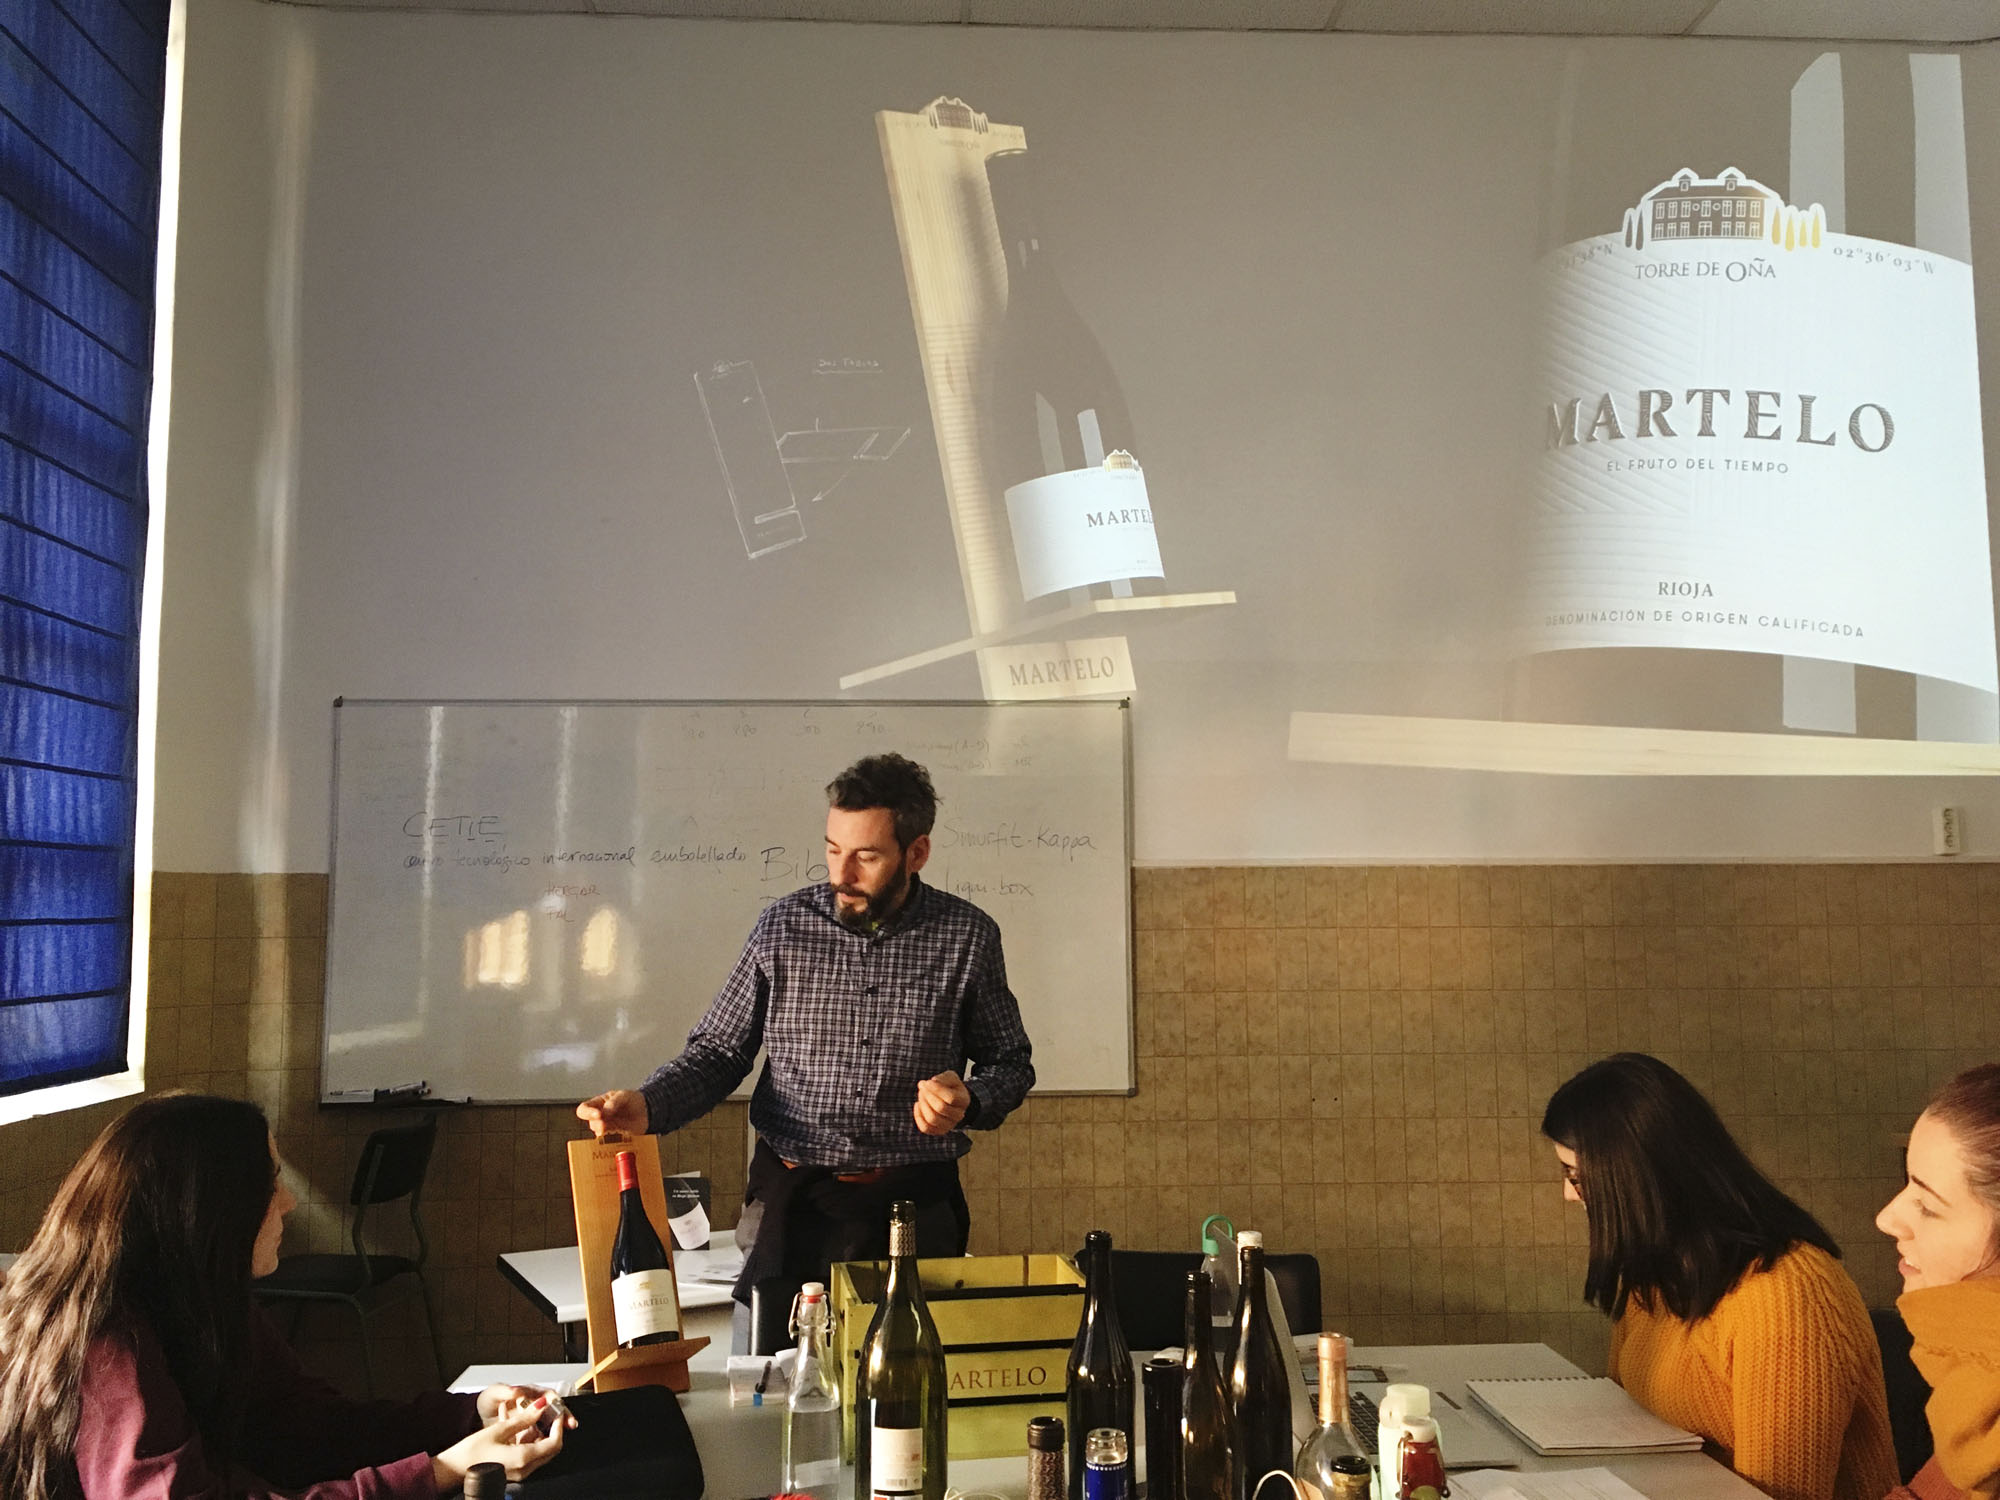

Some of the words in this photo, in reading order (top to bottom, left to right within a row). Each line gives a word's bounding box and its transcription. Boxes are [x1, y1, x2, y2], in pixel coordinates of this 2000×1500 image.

[1635, 263, 1690, 280] TORRE
[1696, 262, 1720, 276] DE
[1725, 257, 1777, 282] OÑA
[1546, 388, 1895, 453] MARTELO
[1607, 461, 1622, 472] EL
[1628, 458, 1678, 471] FRUTO
[1686, 459, 1716, 471] DEL
[1724, 459, 1790, 475] TIEMPO
[1086, 508, 1154, 528] MARTEL
[1657, 581, 1715, 600] RIOJA
[1545, 609, 1646, 627] DENOMINACIÓN
[1653, 610, 1673, 622] DE
[1681, 611, 1749, 626] ORIGEN
[1758, 615, 1865, 638] CALIFICADA
[1008, 655, 1115, 687] MARTELO
[950, 1366, 1047, 1391] ARTELO
